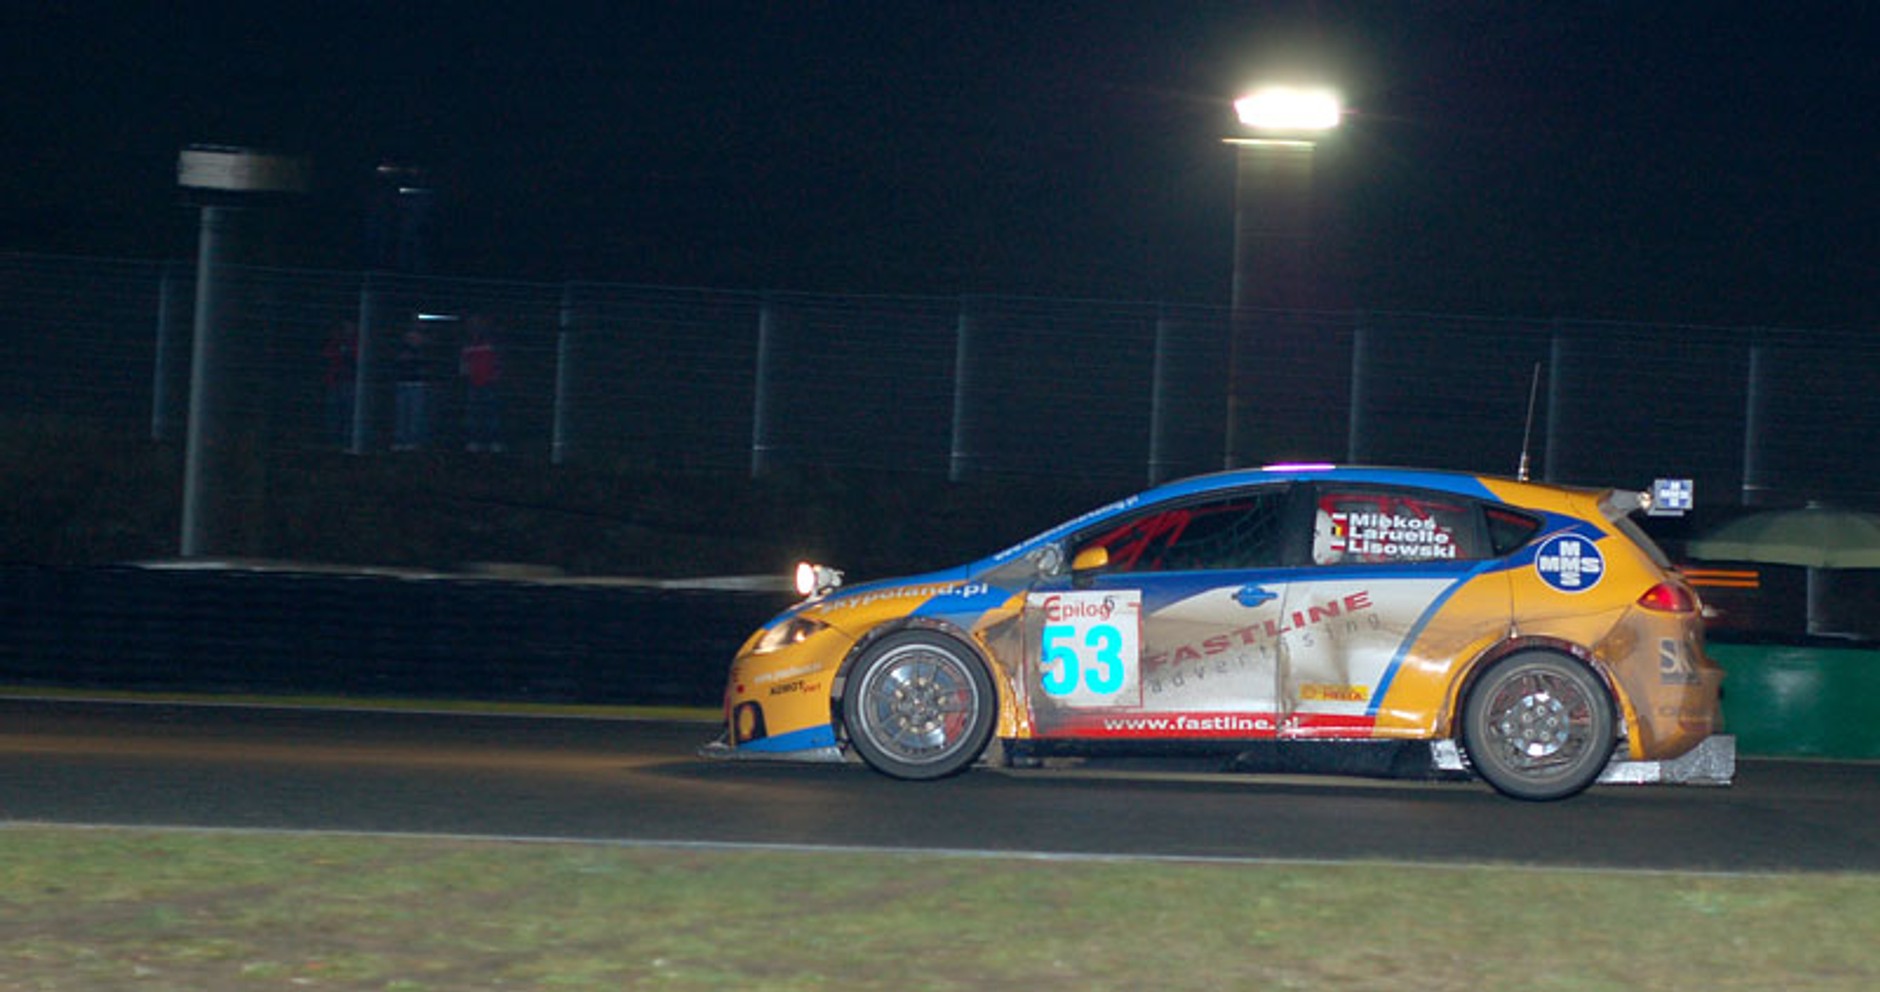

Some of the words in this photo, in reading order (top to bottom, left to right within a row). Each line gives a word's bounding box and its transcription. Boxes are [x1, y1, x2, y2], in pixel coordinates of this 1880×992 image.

[1347, 540, 1457, 559] Lisowski
[1349, 526, 1450, 545] Laruelle
[1042, 594, 1111, 622] Epilog
[1146, 590, 1374, 672] FASTLINE
[1040, 623, 1125, 696] 53
[1151, 613, 1381, 694] advertising
